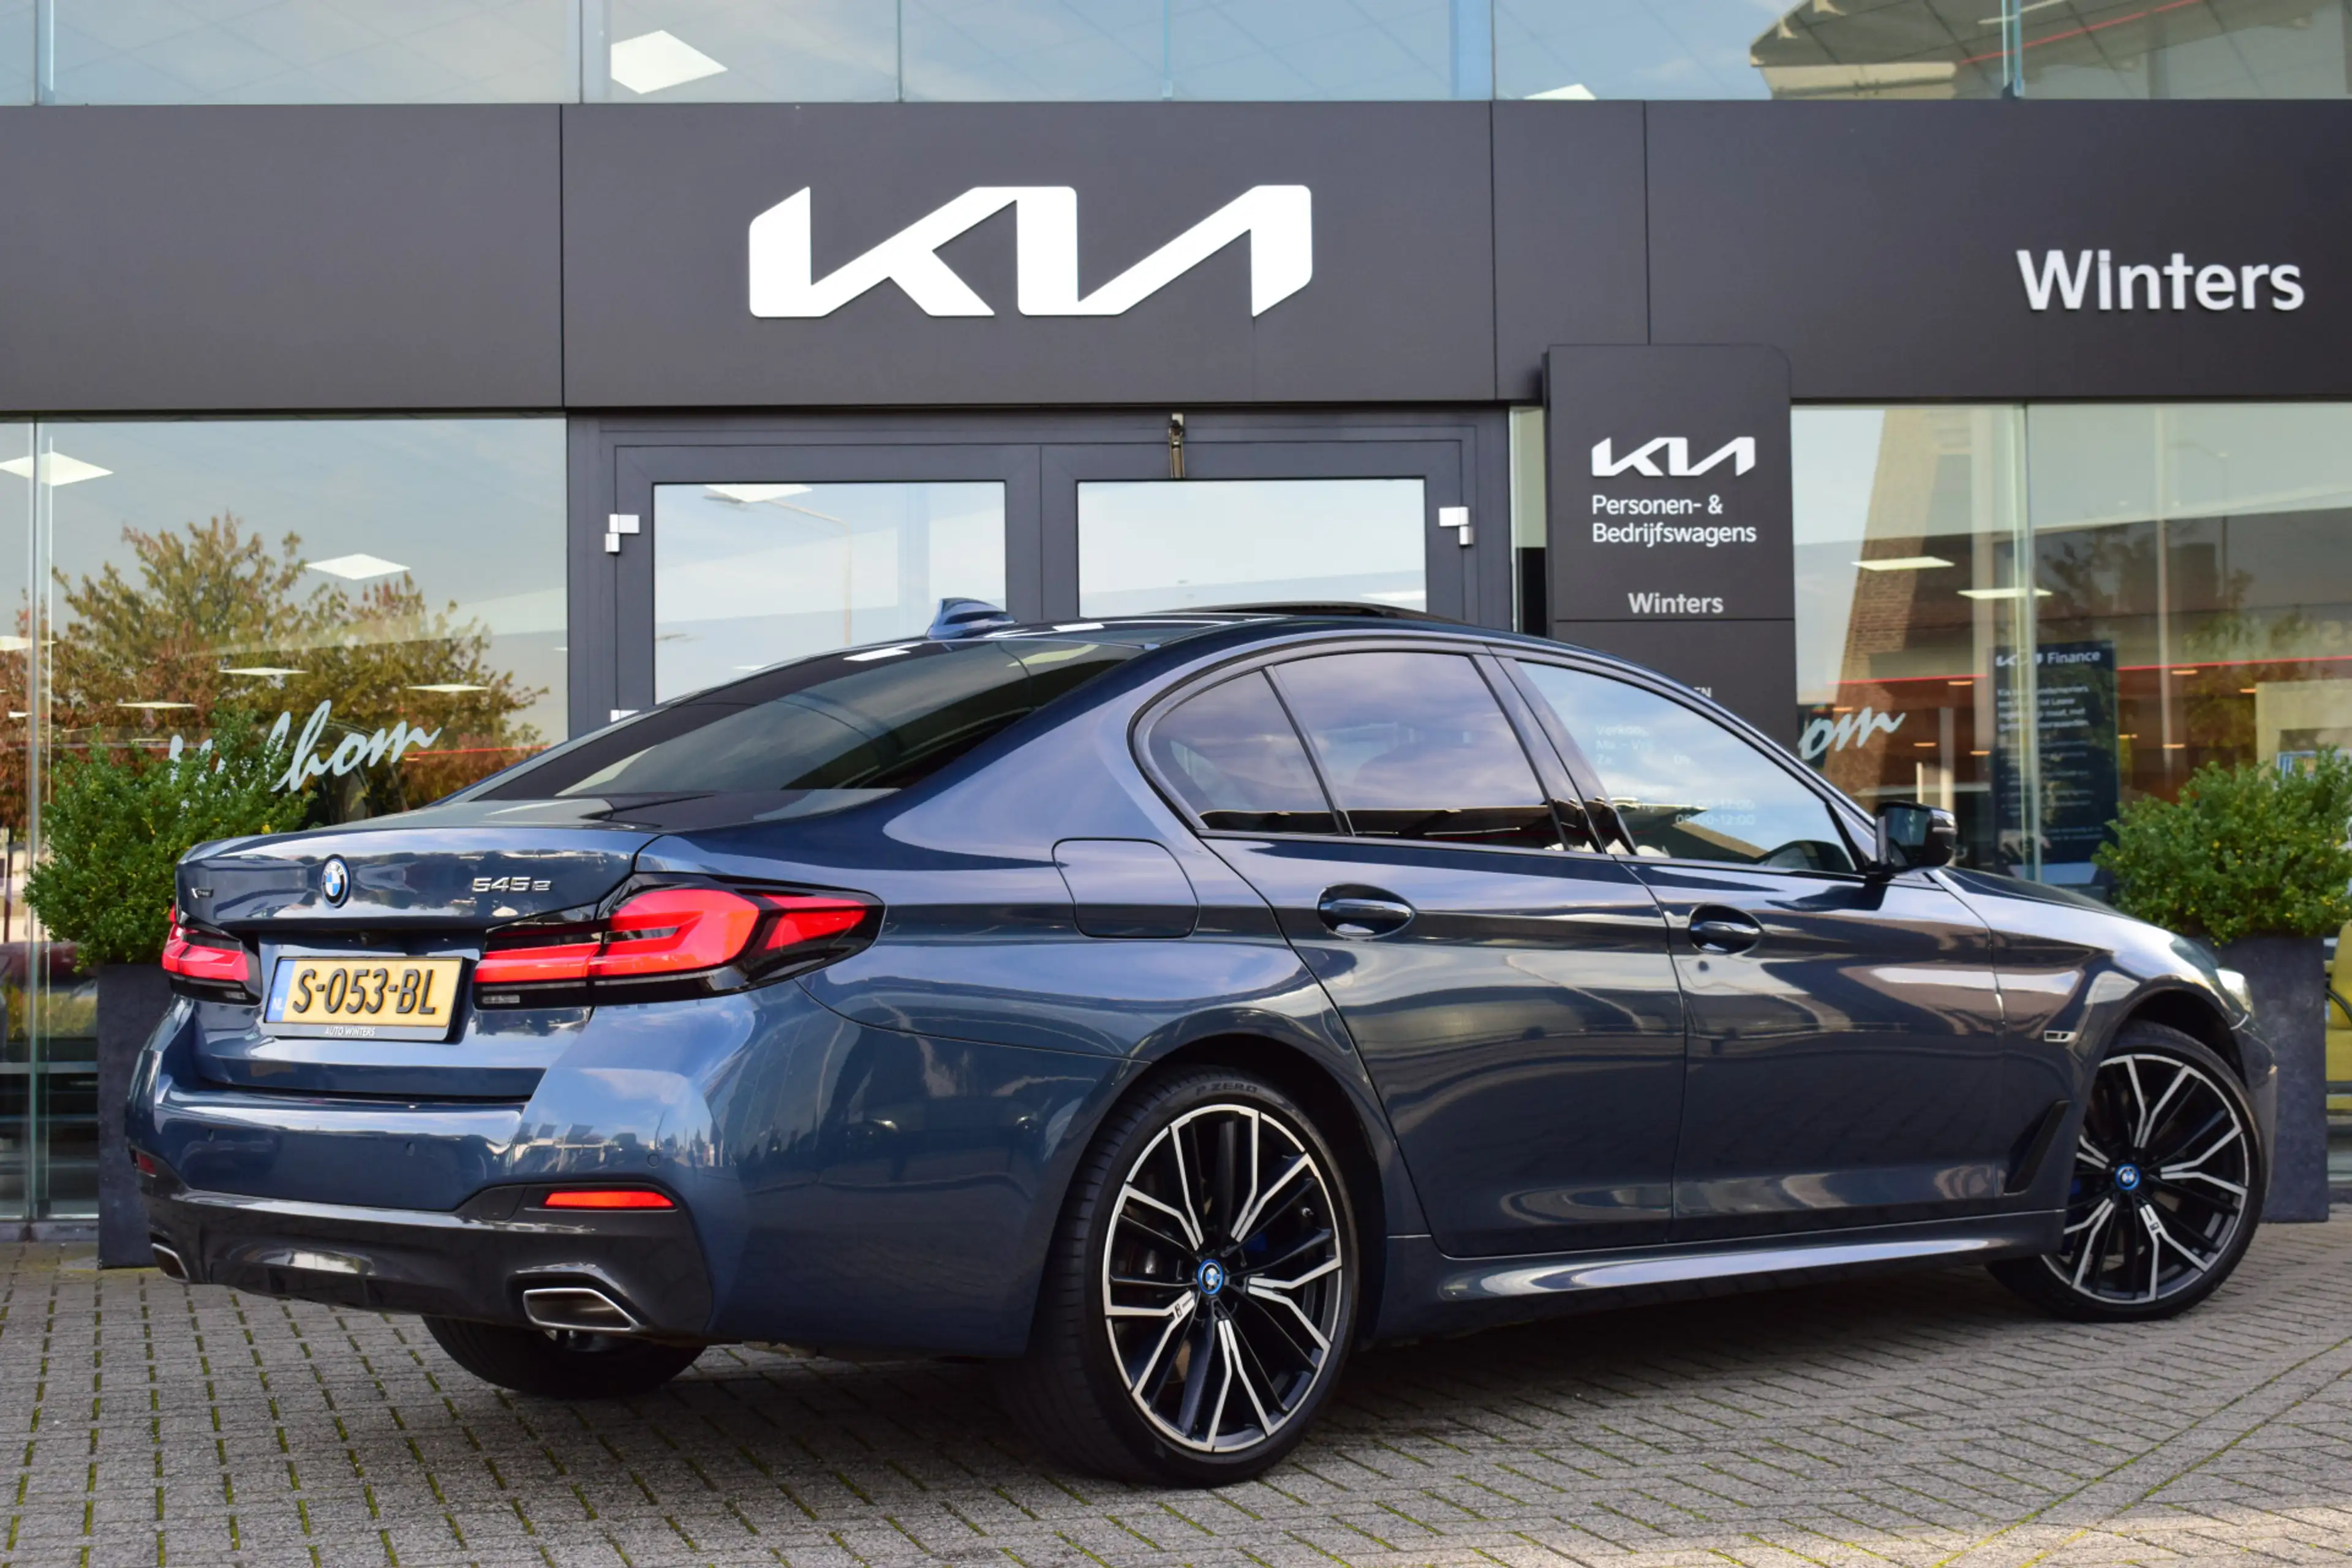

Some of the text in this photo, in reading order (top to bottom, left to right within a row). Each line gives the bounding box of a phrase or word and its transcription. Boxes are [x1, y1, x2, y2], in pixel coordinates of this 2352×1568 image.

[748, 185, 1313, 318] KIA
[2016, 249, 2305, 311] Winters
[1591, 436, 1755, 477] KIA
[1592, 494, 1723, 515] Personen- &
[1592, 522, 1758, 548] Bedrijfswagens
[1627, 592, 1724, 614] Winters
[2046, 651, 2101, 665] Finance
[472, 876, 551, 892] 545e
[292, 967, 436, 1014] S-053-BL
